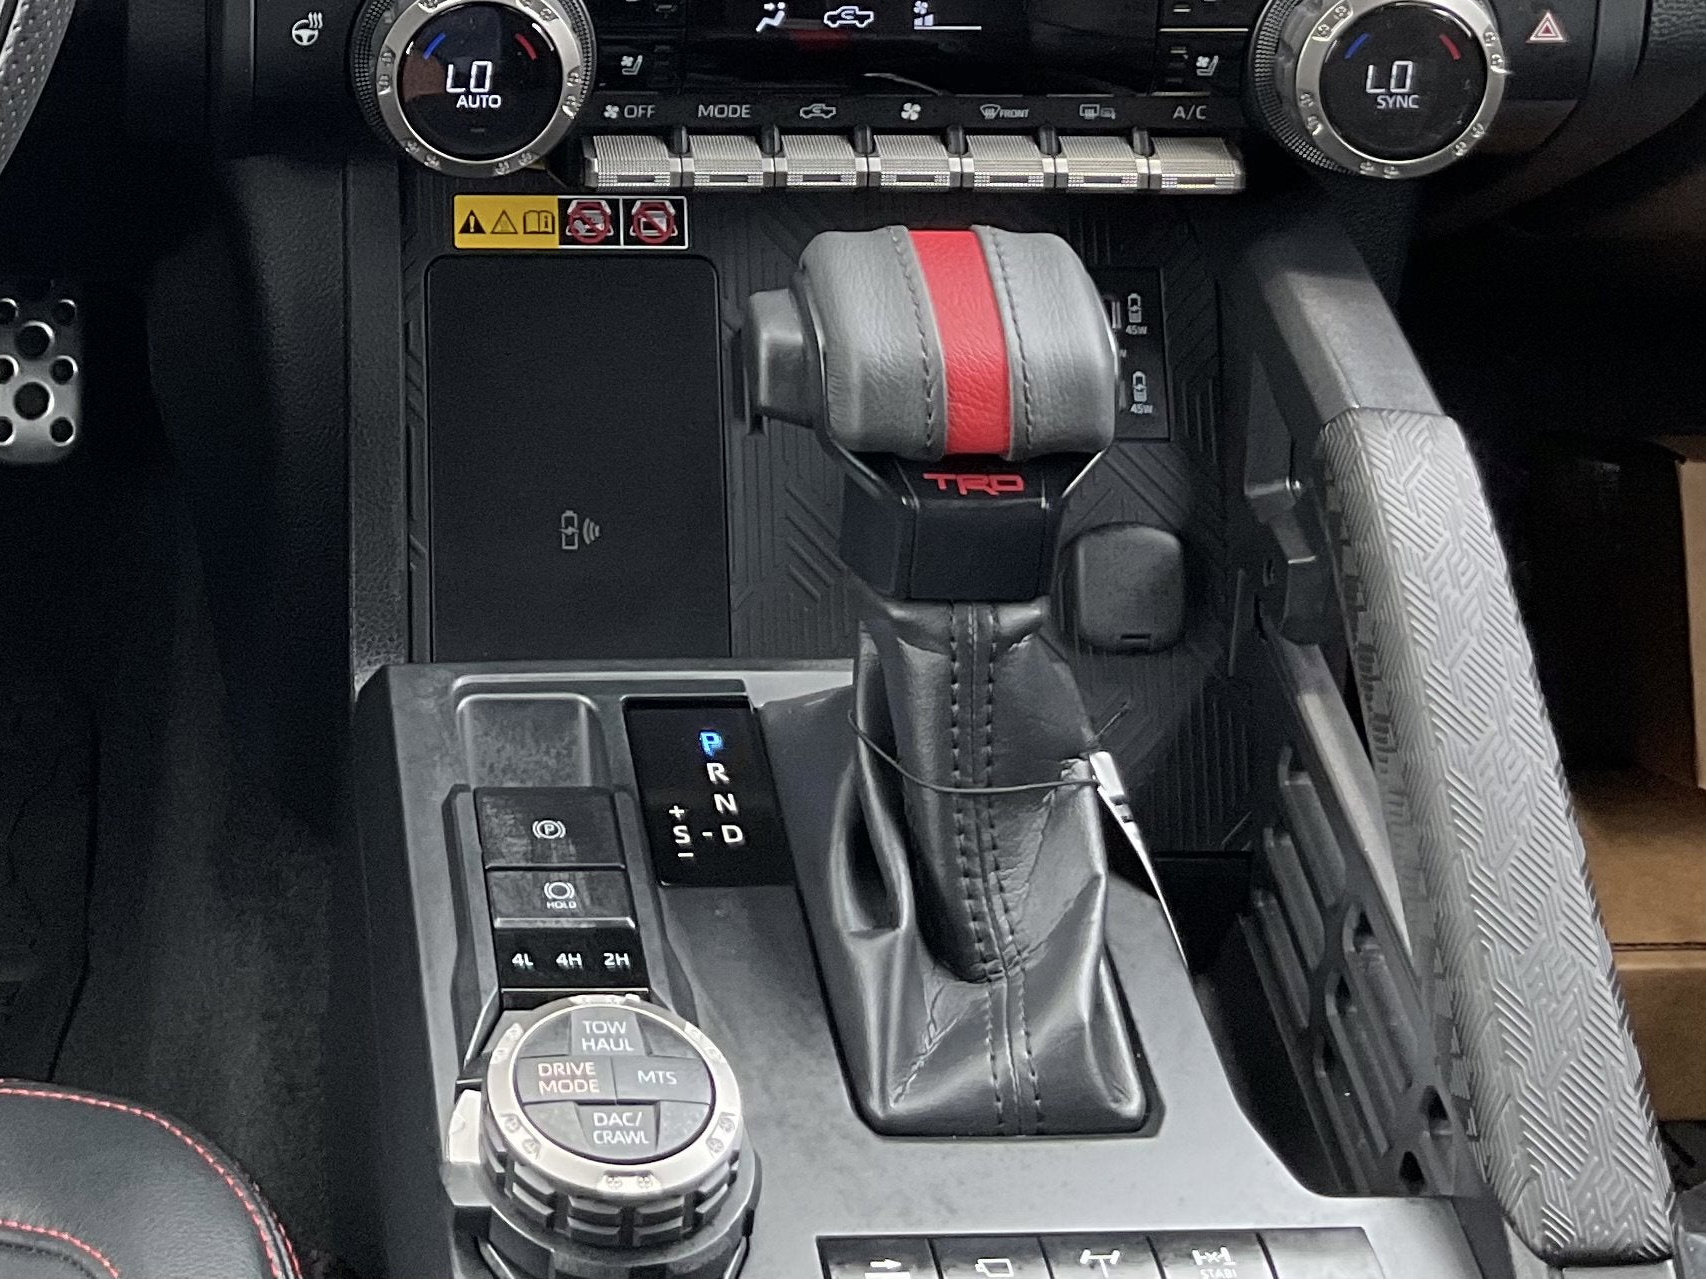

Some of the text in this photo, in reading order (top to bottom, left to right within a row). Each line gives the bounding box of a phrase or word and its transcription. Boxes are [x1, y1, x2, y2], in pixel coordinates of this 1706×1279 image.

[446, 60, 493, 94] LO
[1365, 60, 1414, 94] LO
[456, 94, 502, 109] AUTO
[1376, 94, 1420, 109] SYNC
[623, 104, 656, 119] OFF
[697, 104, 751, 119] MODE
[999, 107, 1030, 118] FRONT
[1172, 105, 1208, 120] A/C
[1126, 325, 1149, 336] 45W
[1130, 403, 1154, 414] 45W
[922, 472, 1025, 496] TRD
[699, 730, 723, 754] P
[706, 762, 730, 784] R
[714, 793, 738, 816] N
[673, 825, 691, 845] S
[721, 825, 744, 845] D
[546, 901, 577, 910] HOLD
[511, 953, 534, 968] 4L
[555, 953, 583, 968] 4H
[603, 952, 630, 968] 2H
[581, 1021, 627, 1034] TOW
[581, 1038, 634, 1052] HAUL
[537, 1062, 596, 1077] DRIVE
[637, 1070, 678, 1086] MTS
[538, 1079, 600, 1095] MODE
[593, 1111, 642, 1128] DAC/
[592, 1130, 650, 1145] CRAWL
